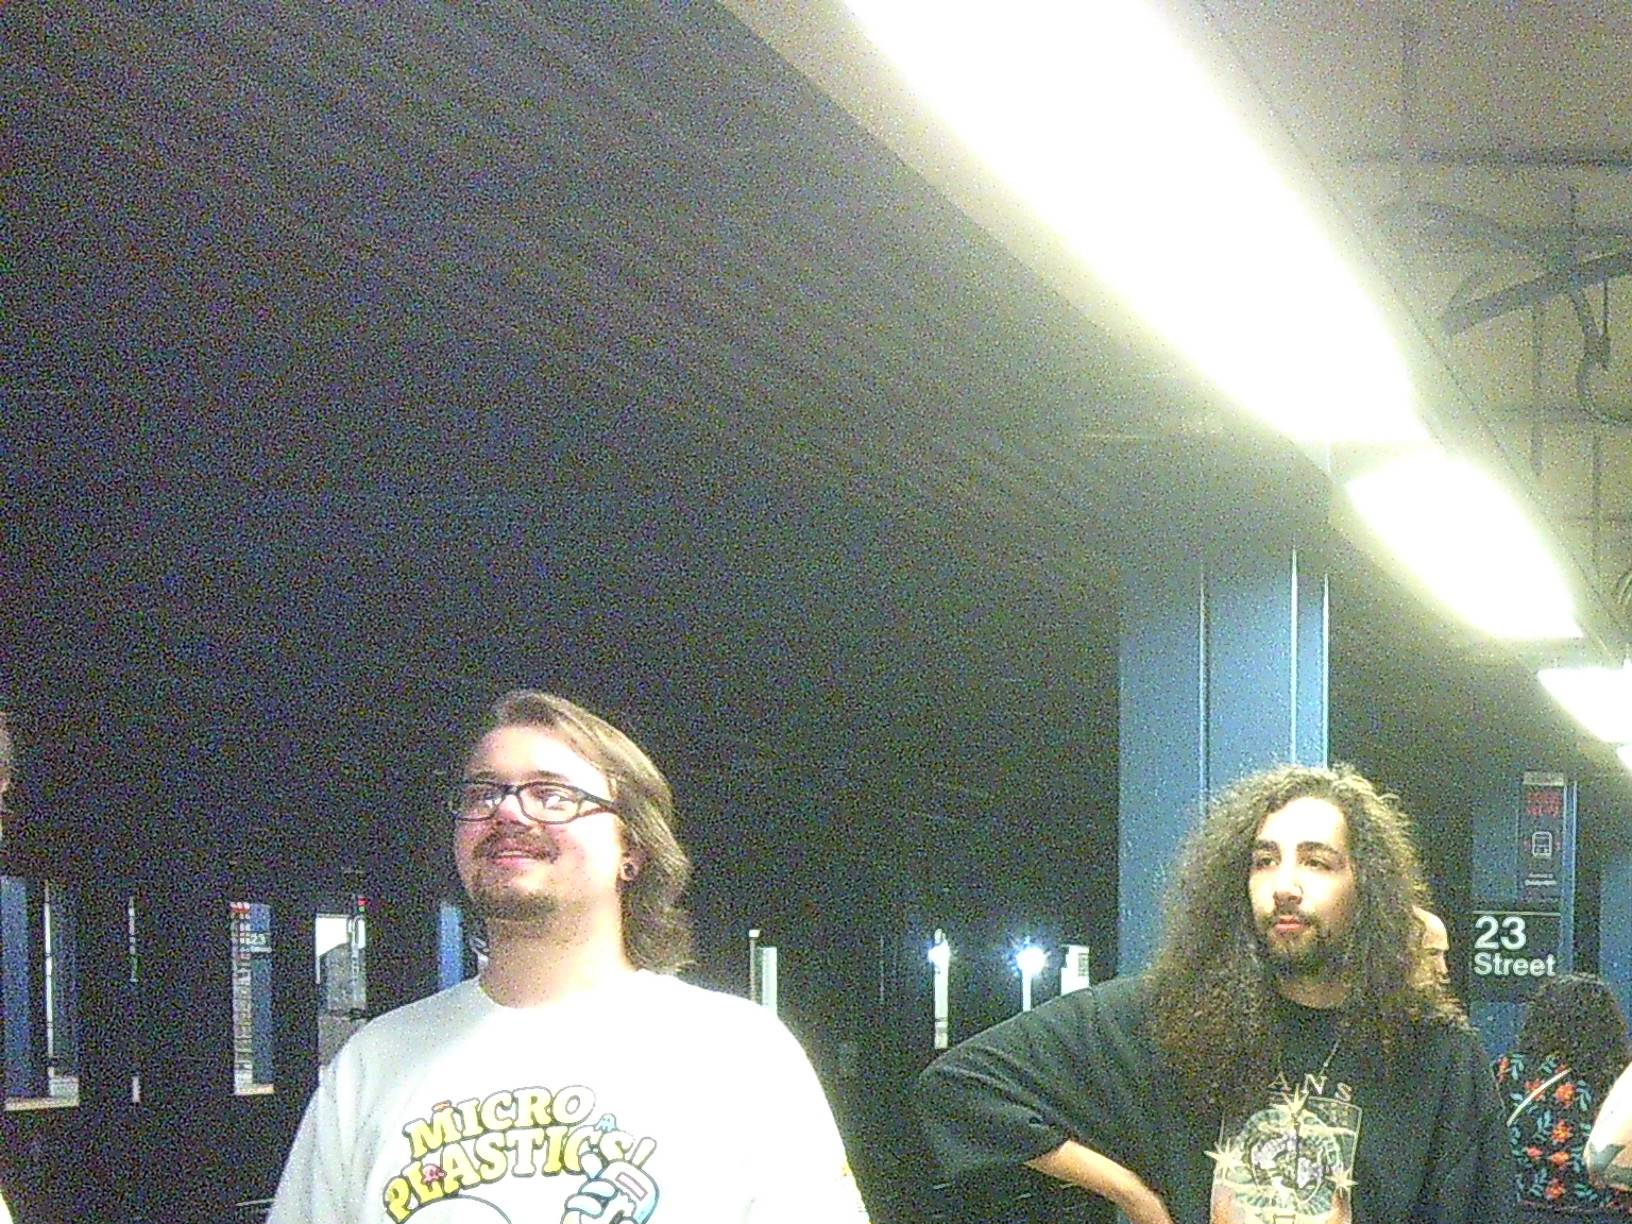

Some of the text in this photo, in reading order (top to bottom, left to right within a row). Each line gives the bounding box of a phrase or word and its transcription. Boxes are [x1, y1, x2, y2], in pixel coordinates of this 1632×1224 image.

[1474, 915, 1527, 950] 23
[1474, 951, 1557, 977] Street
[402, 1084, 597, 1160] MICRO
